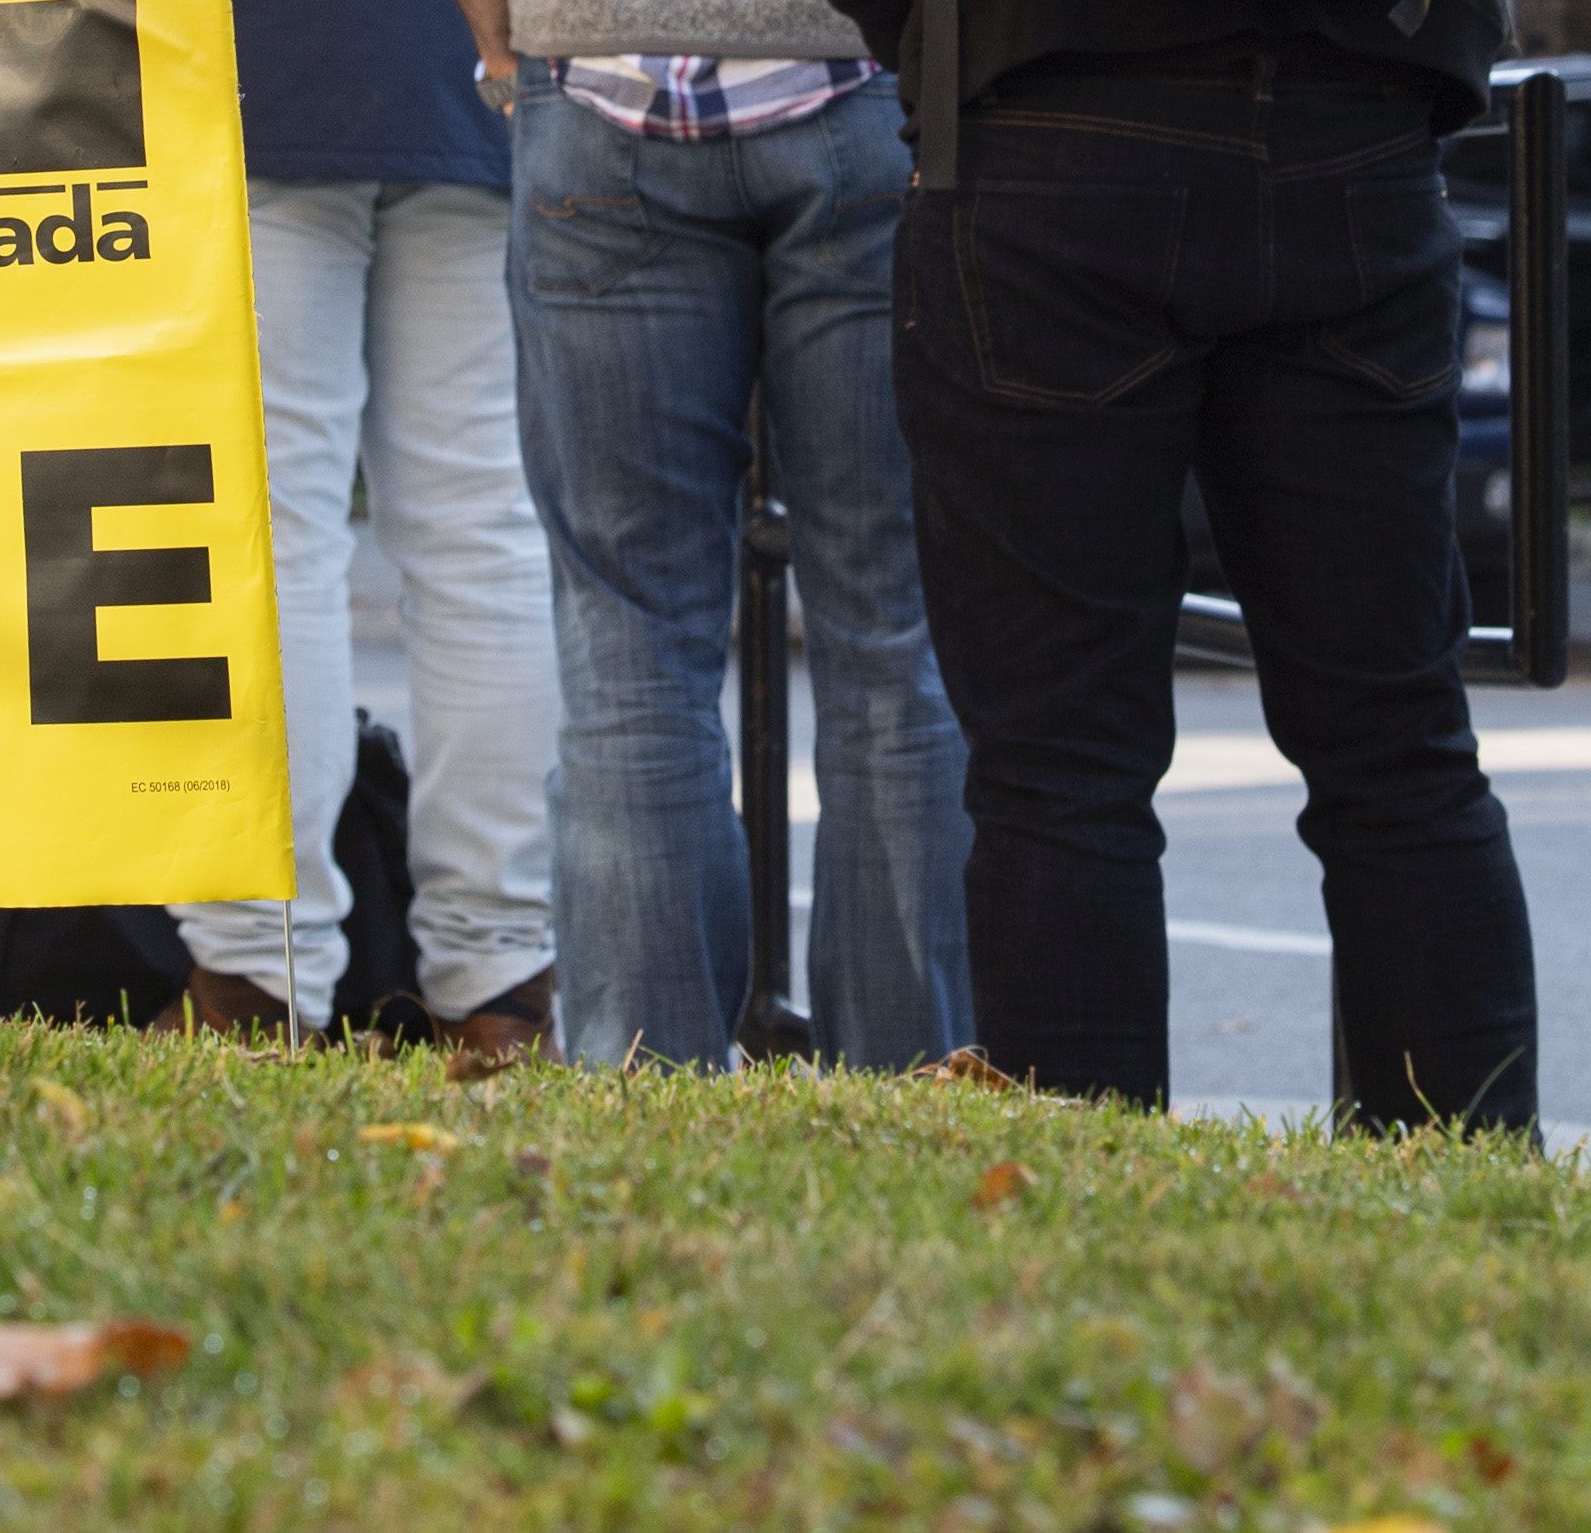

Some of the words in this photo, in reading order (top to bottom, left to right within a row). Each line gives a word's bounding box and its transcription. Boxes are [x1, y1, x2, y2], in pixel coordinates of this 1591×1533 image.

[131, 782, 147, 793] EC
[149, 781, 181, 793] 50168
[183, 779, 231, 794] (06/2018)
